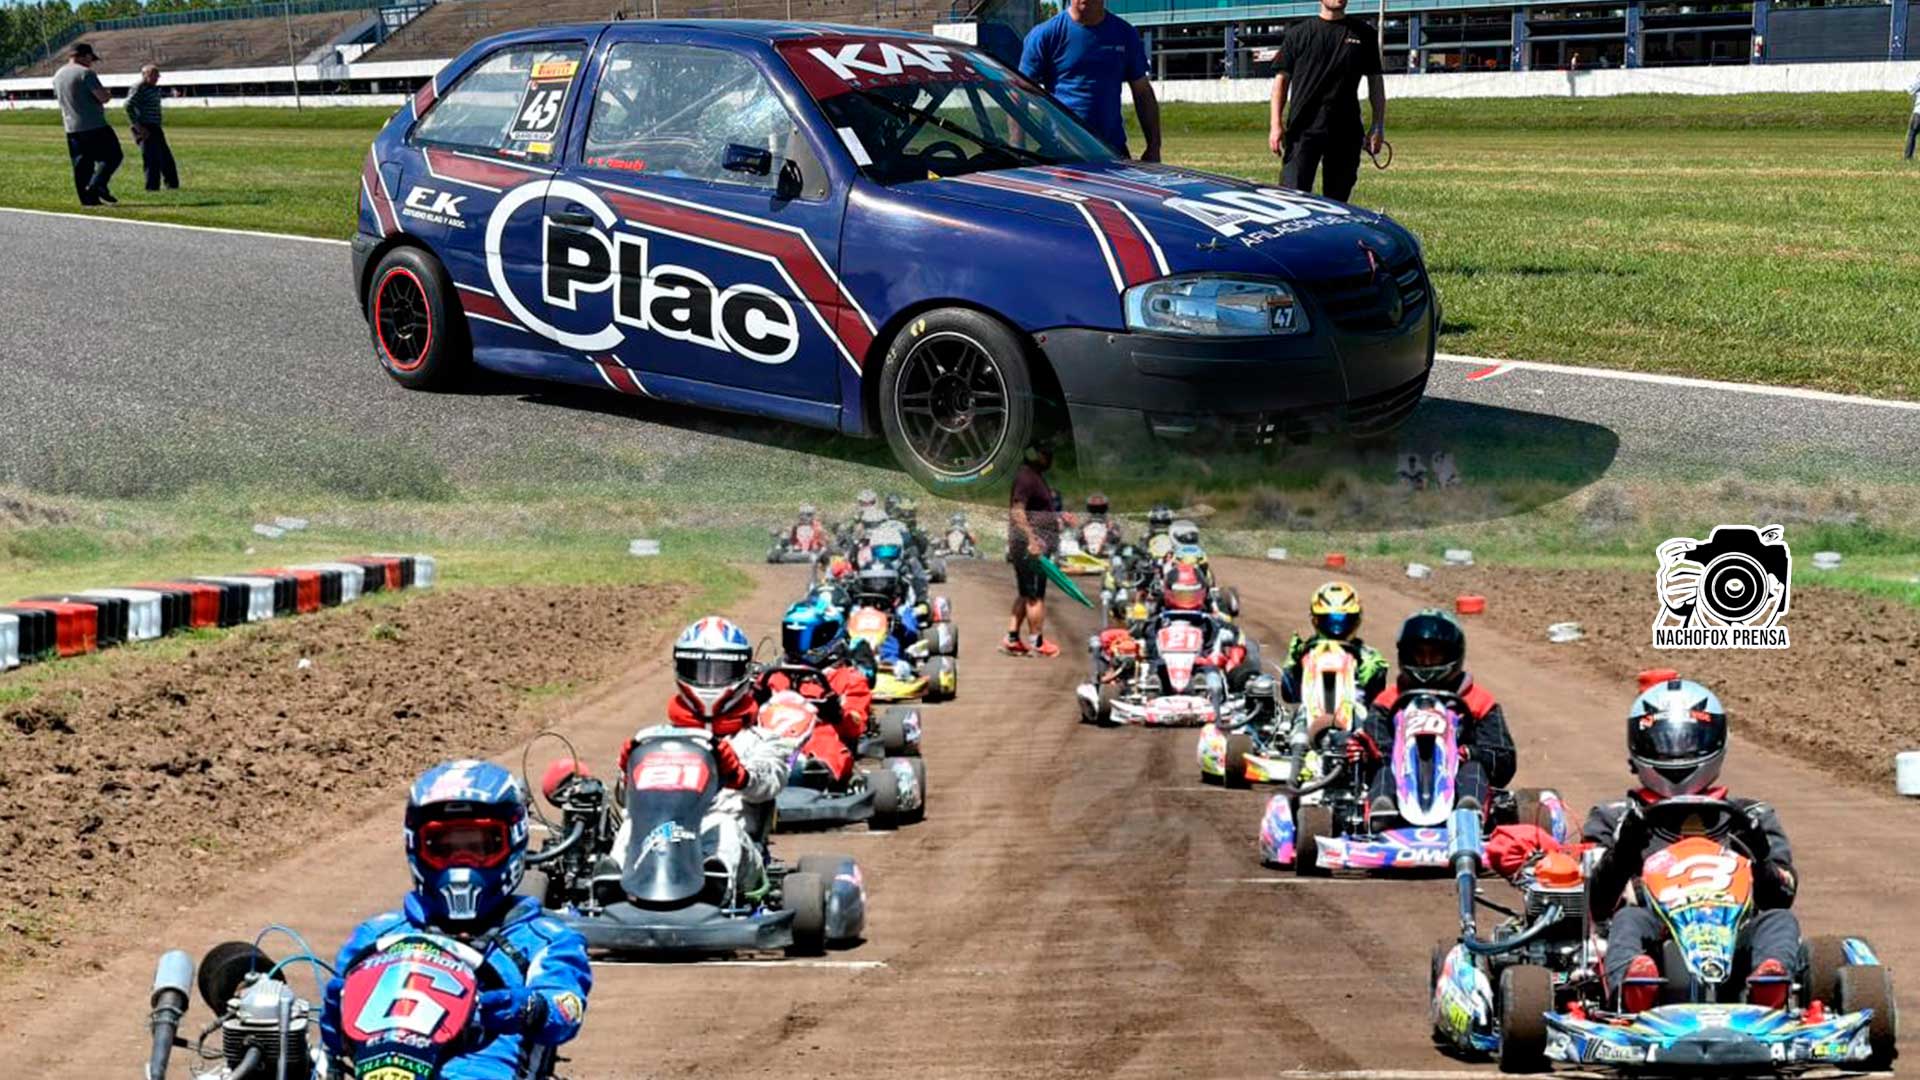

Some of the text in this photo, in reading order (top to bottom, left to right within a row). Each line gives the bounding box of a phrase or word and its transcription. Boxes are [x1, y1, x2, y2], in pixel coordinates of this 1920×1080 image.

[521, 90, 563, 130] 45
[1162, 188, 1351, 238] ADS
[1273, 308, 1293, 327] 47
[1405, 715, 1447, 738] 20
[1658, 854, 1738, 904] 3
[353, 961, 468, 1036] 6
